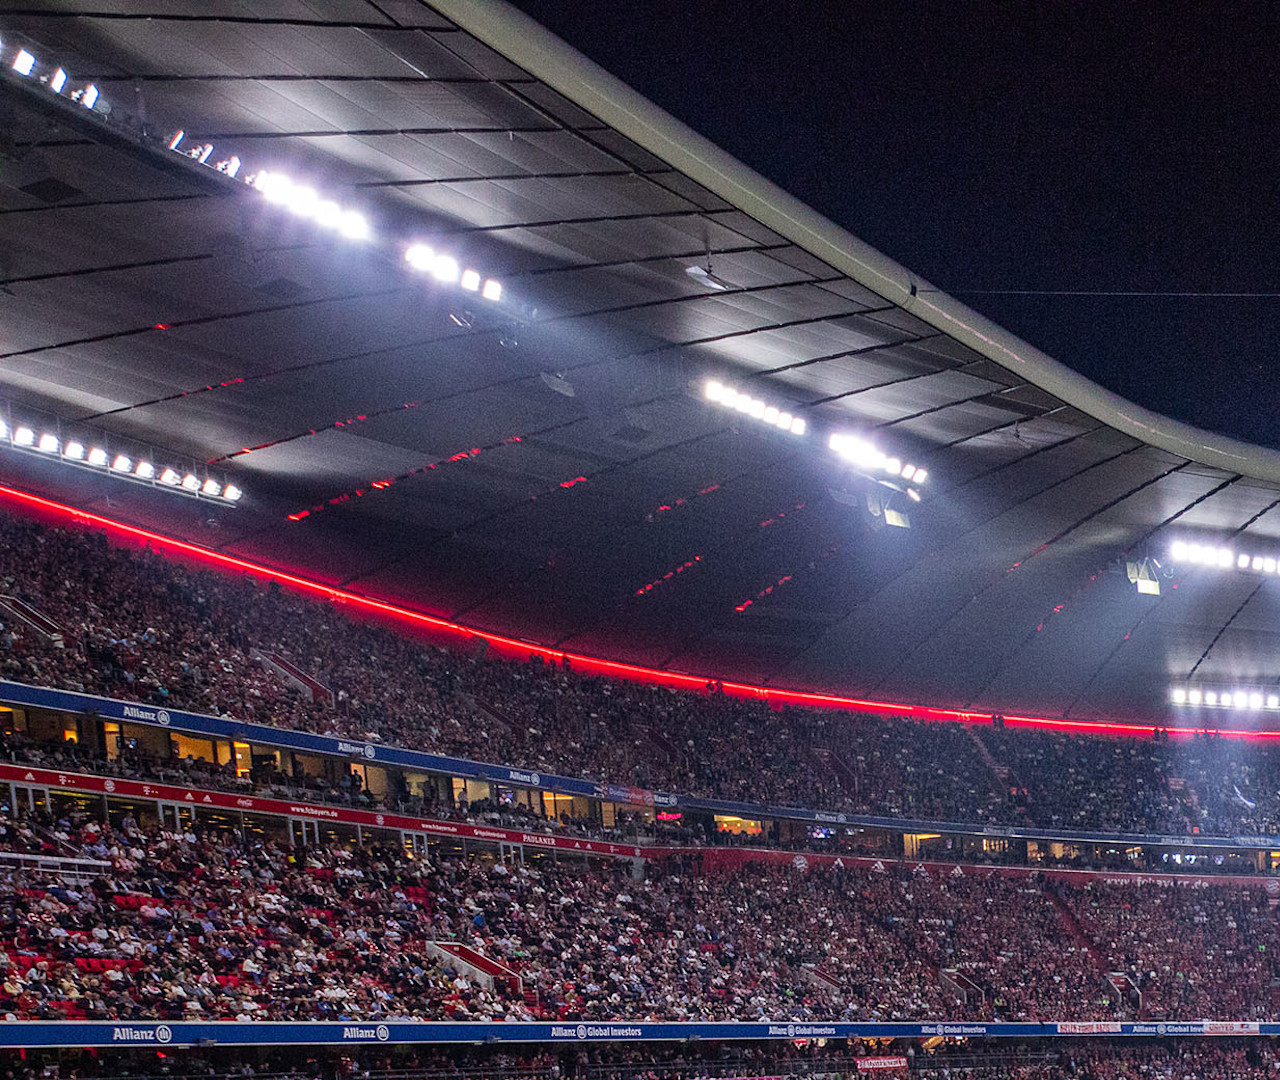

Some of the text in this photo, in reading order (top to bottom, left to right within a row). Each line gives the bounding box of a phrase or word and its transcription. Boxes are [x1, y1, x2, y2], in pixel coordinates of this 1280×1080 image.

[124, 706, 157, 722] Allianz
[338, 742, 364, 755] Allianz
[510, 772, 531, 783] Allianz
[523, 834, 556, 846] PAULANER
[113, 1028, 154, 1041] Allianz
[342, 1027, 375, 1039] Allianz
[551, 1026, 642, 1037] Allianz Global Investors
[768, 1026, 836, 1035] Allianz Global Investors
[921, 1026, 986, 1034] Allianz Global Investors
[1133, 1025, 1190, 1033] Allianz Global
